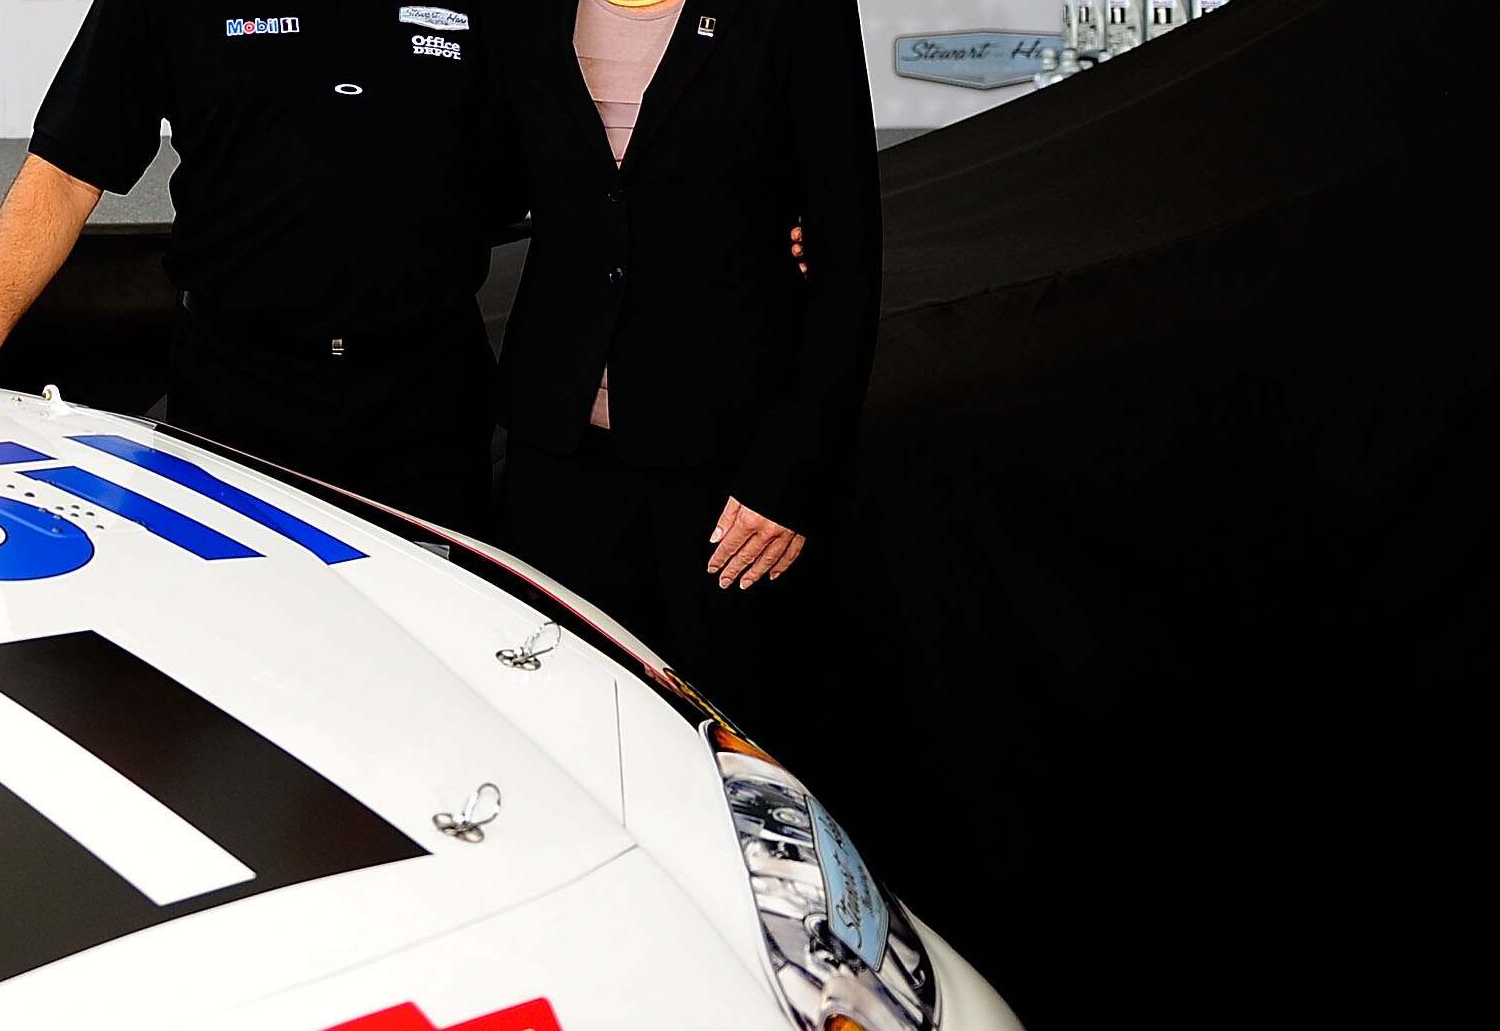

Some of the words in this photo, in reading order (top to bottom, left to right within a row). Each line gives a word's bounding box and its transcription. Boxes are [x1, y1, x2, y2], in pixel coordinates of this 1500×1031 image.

[226, 18, 279, 35] Mobil
[411, 35, 461, 52] Office
[412, 45, 462, 60] DEPOT
